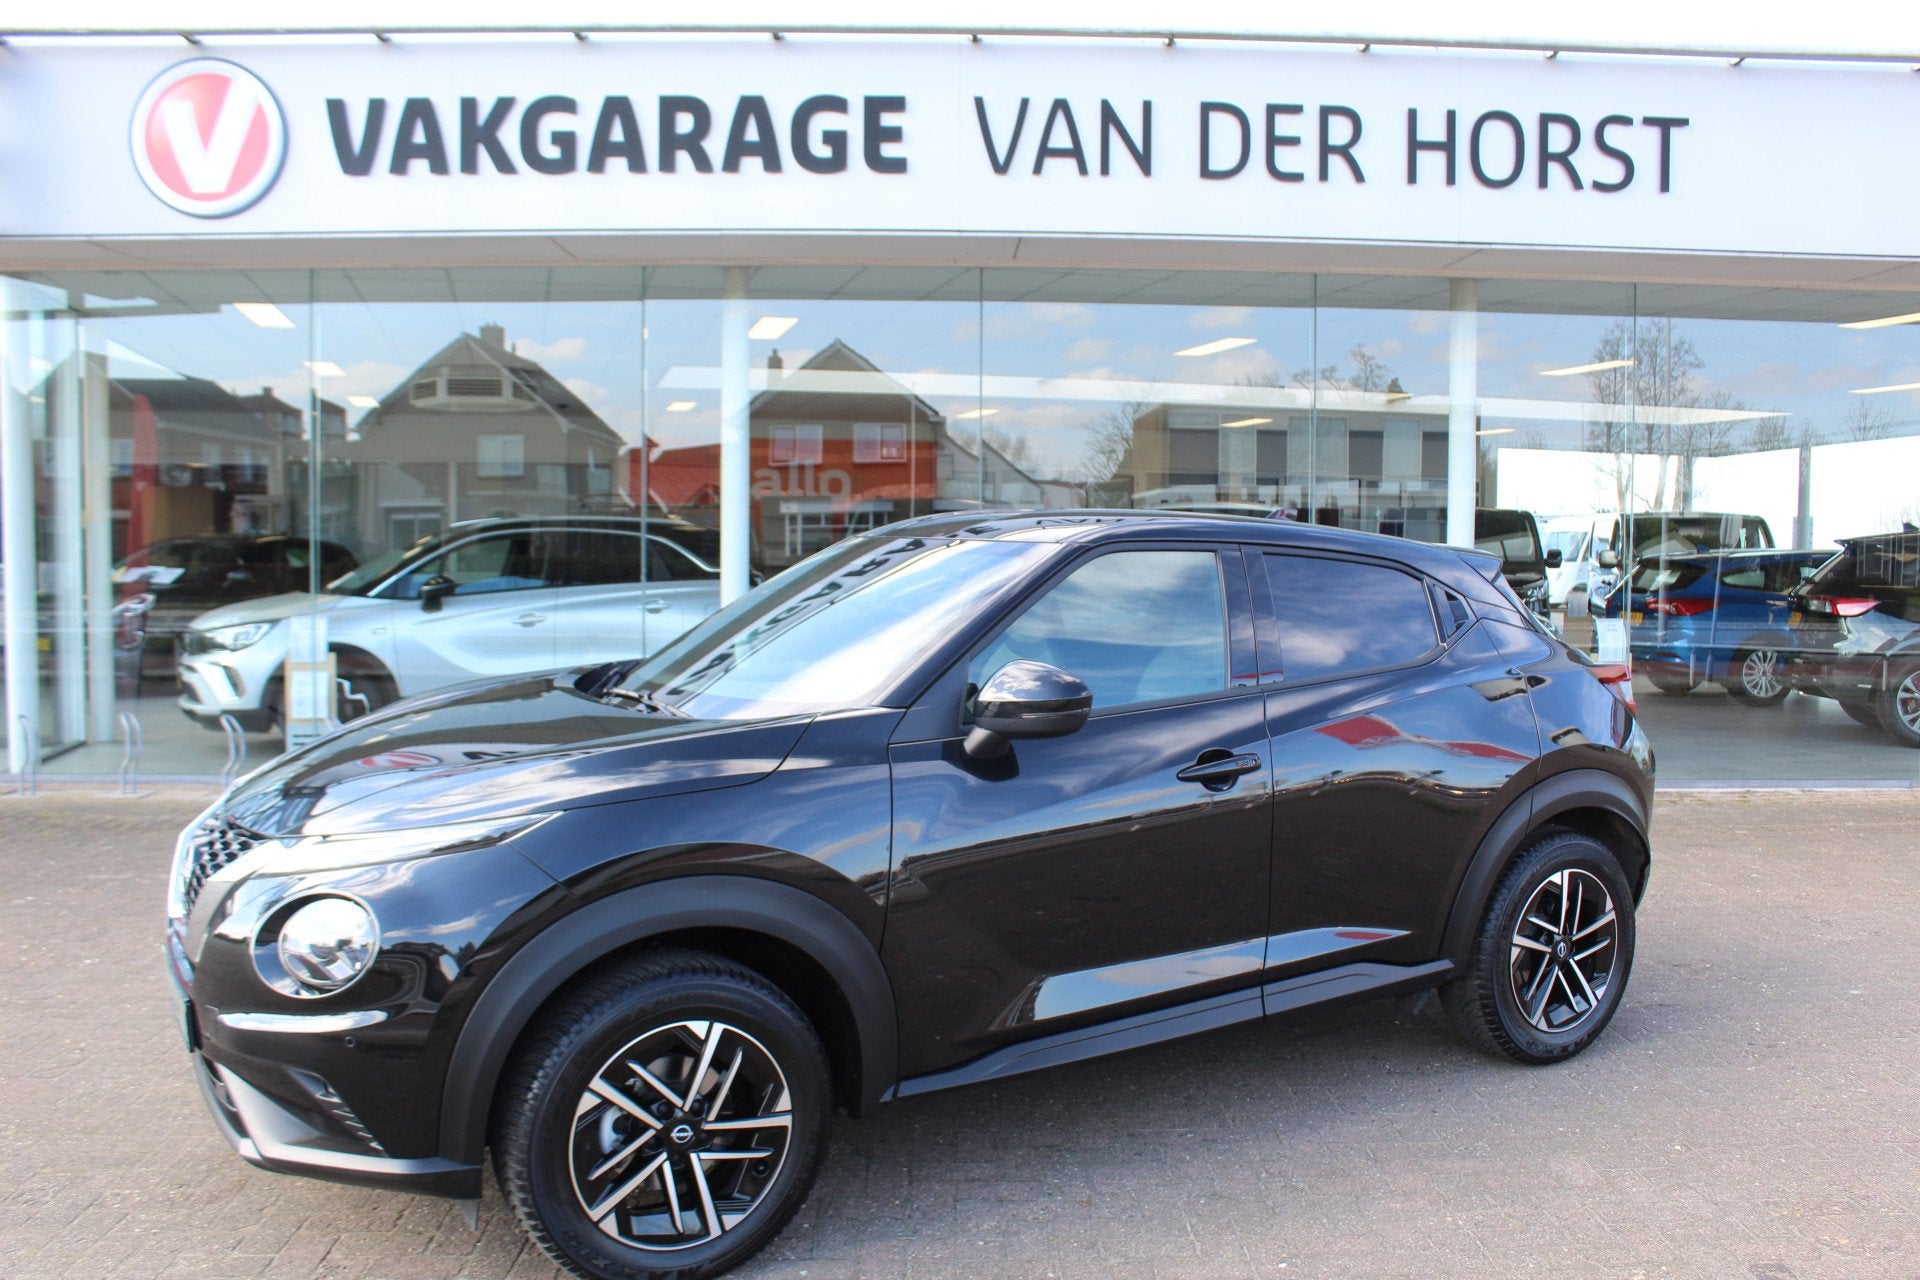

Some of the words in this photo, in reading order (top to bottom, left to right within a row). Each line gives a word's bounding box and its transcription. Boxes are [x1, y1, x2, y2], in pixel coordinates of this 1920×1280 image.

[326, 94, 908, 176] VAKGARAGE
[974, 96, 1152, 177] VAN
[1199, 101, 1366, 183] DER
[1407, 108, 1690, 193] HORST
[750, 459, 852, 499] allo
